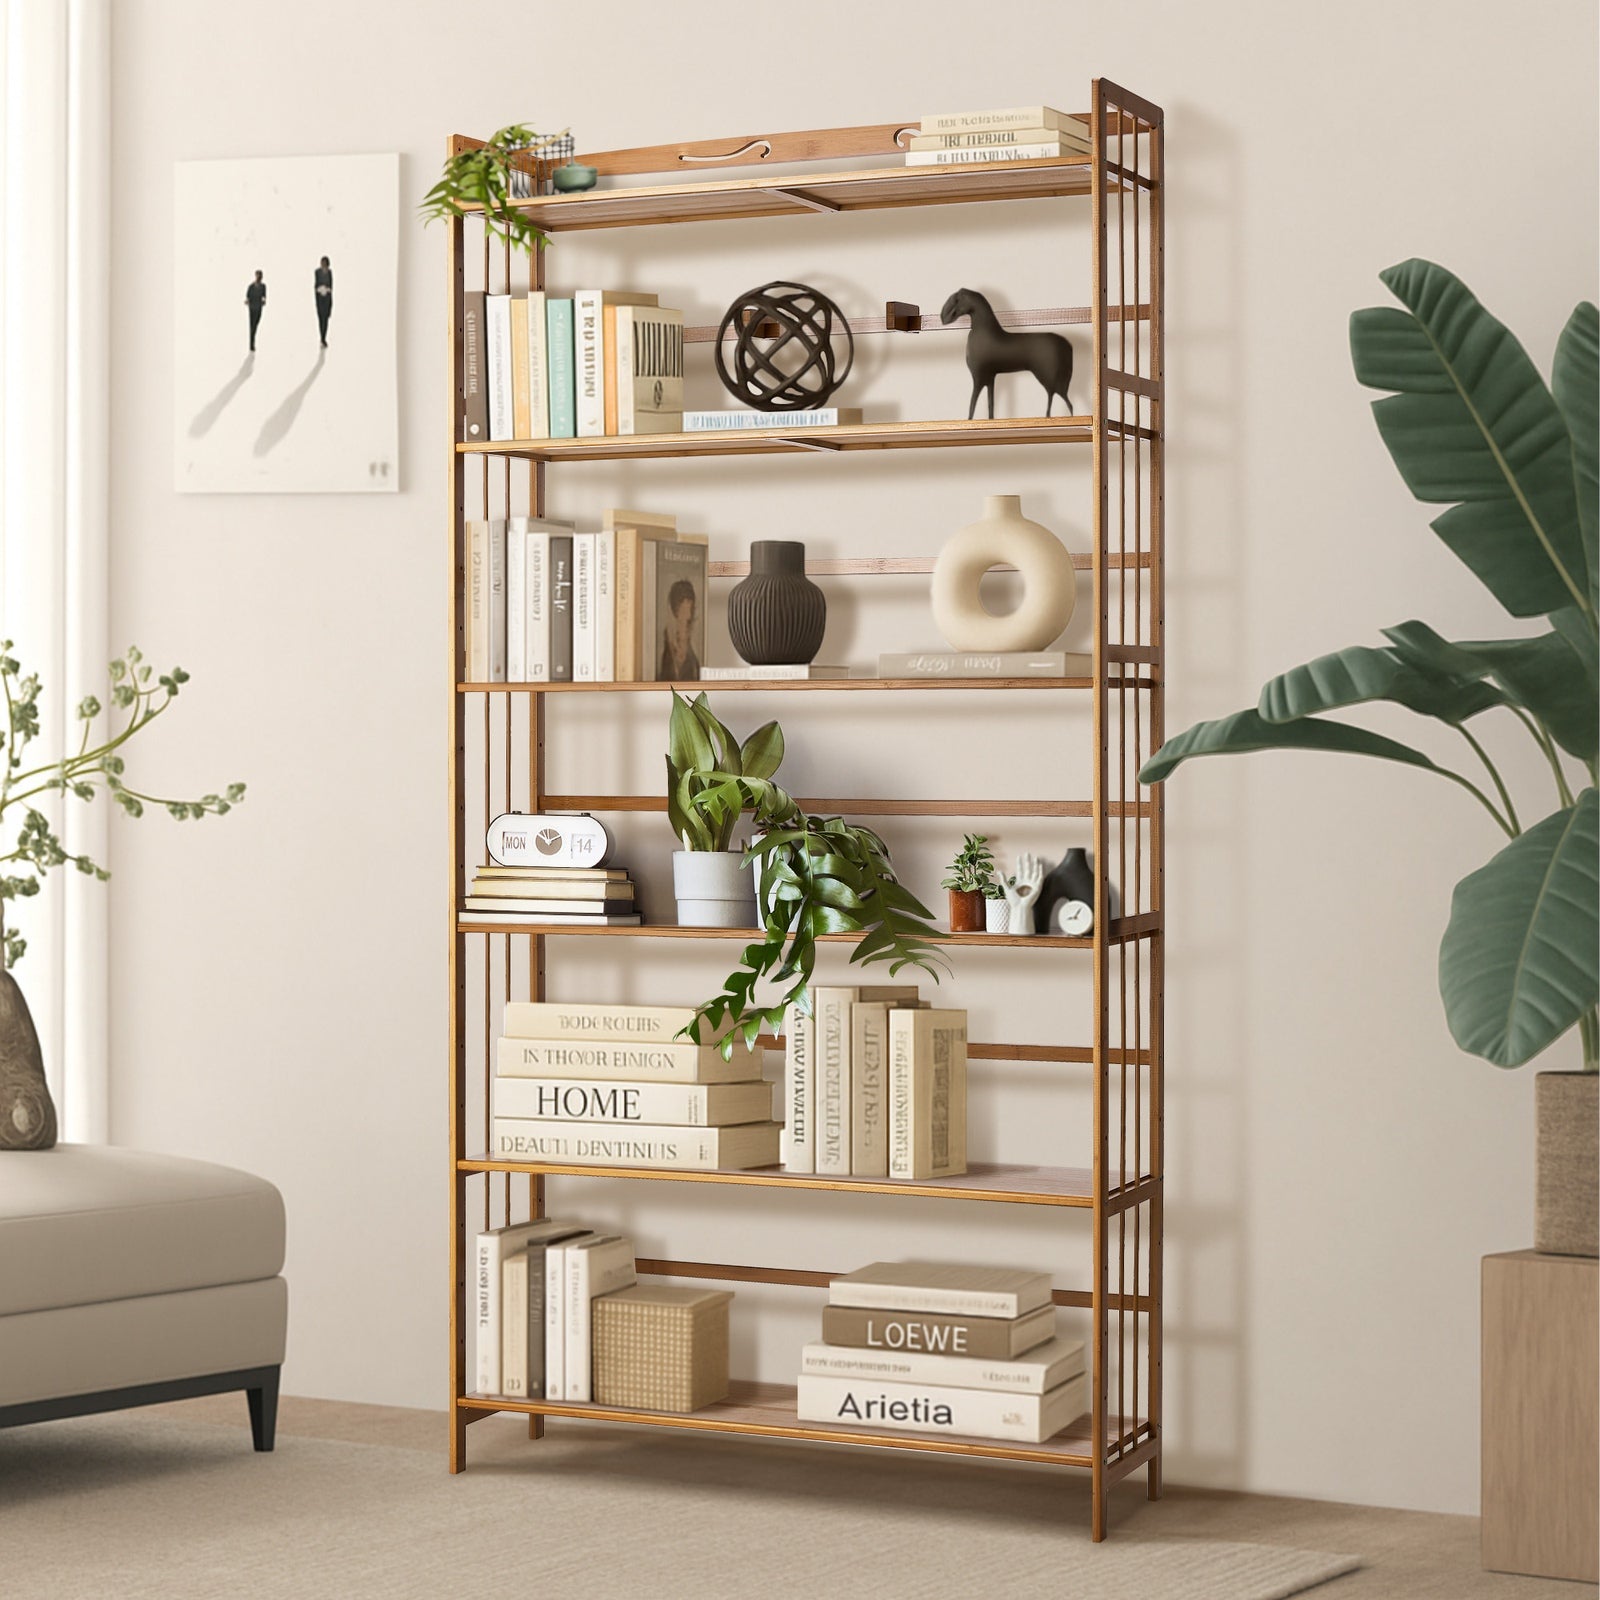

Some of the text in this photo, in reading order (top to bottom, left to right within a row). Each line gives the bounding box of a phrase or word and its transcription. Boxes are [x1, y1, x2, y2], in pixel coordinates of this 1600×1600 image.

[505, 836, 526, 850] MON
[576, 838, 593, 854] 14
[536, 1085, 642, 1120] HOME
[867, 1320, 968, 1352] LOEWE
[837, 1392, 953, 1425] Arietia
